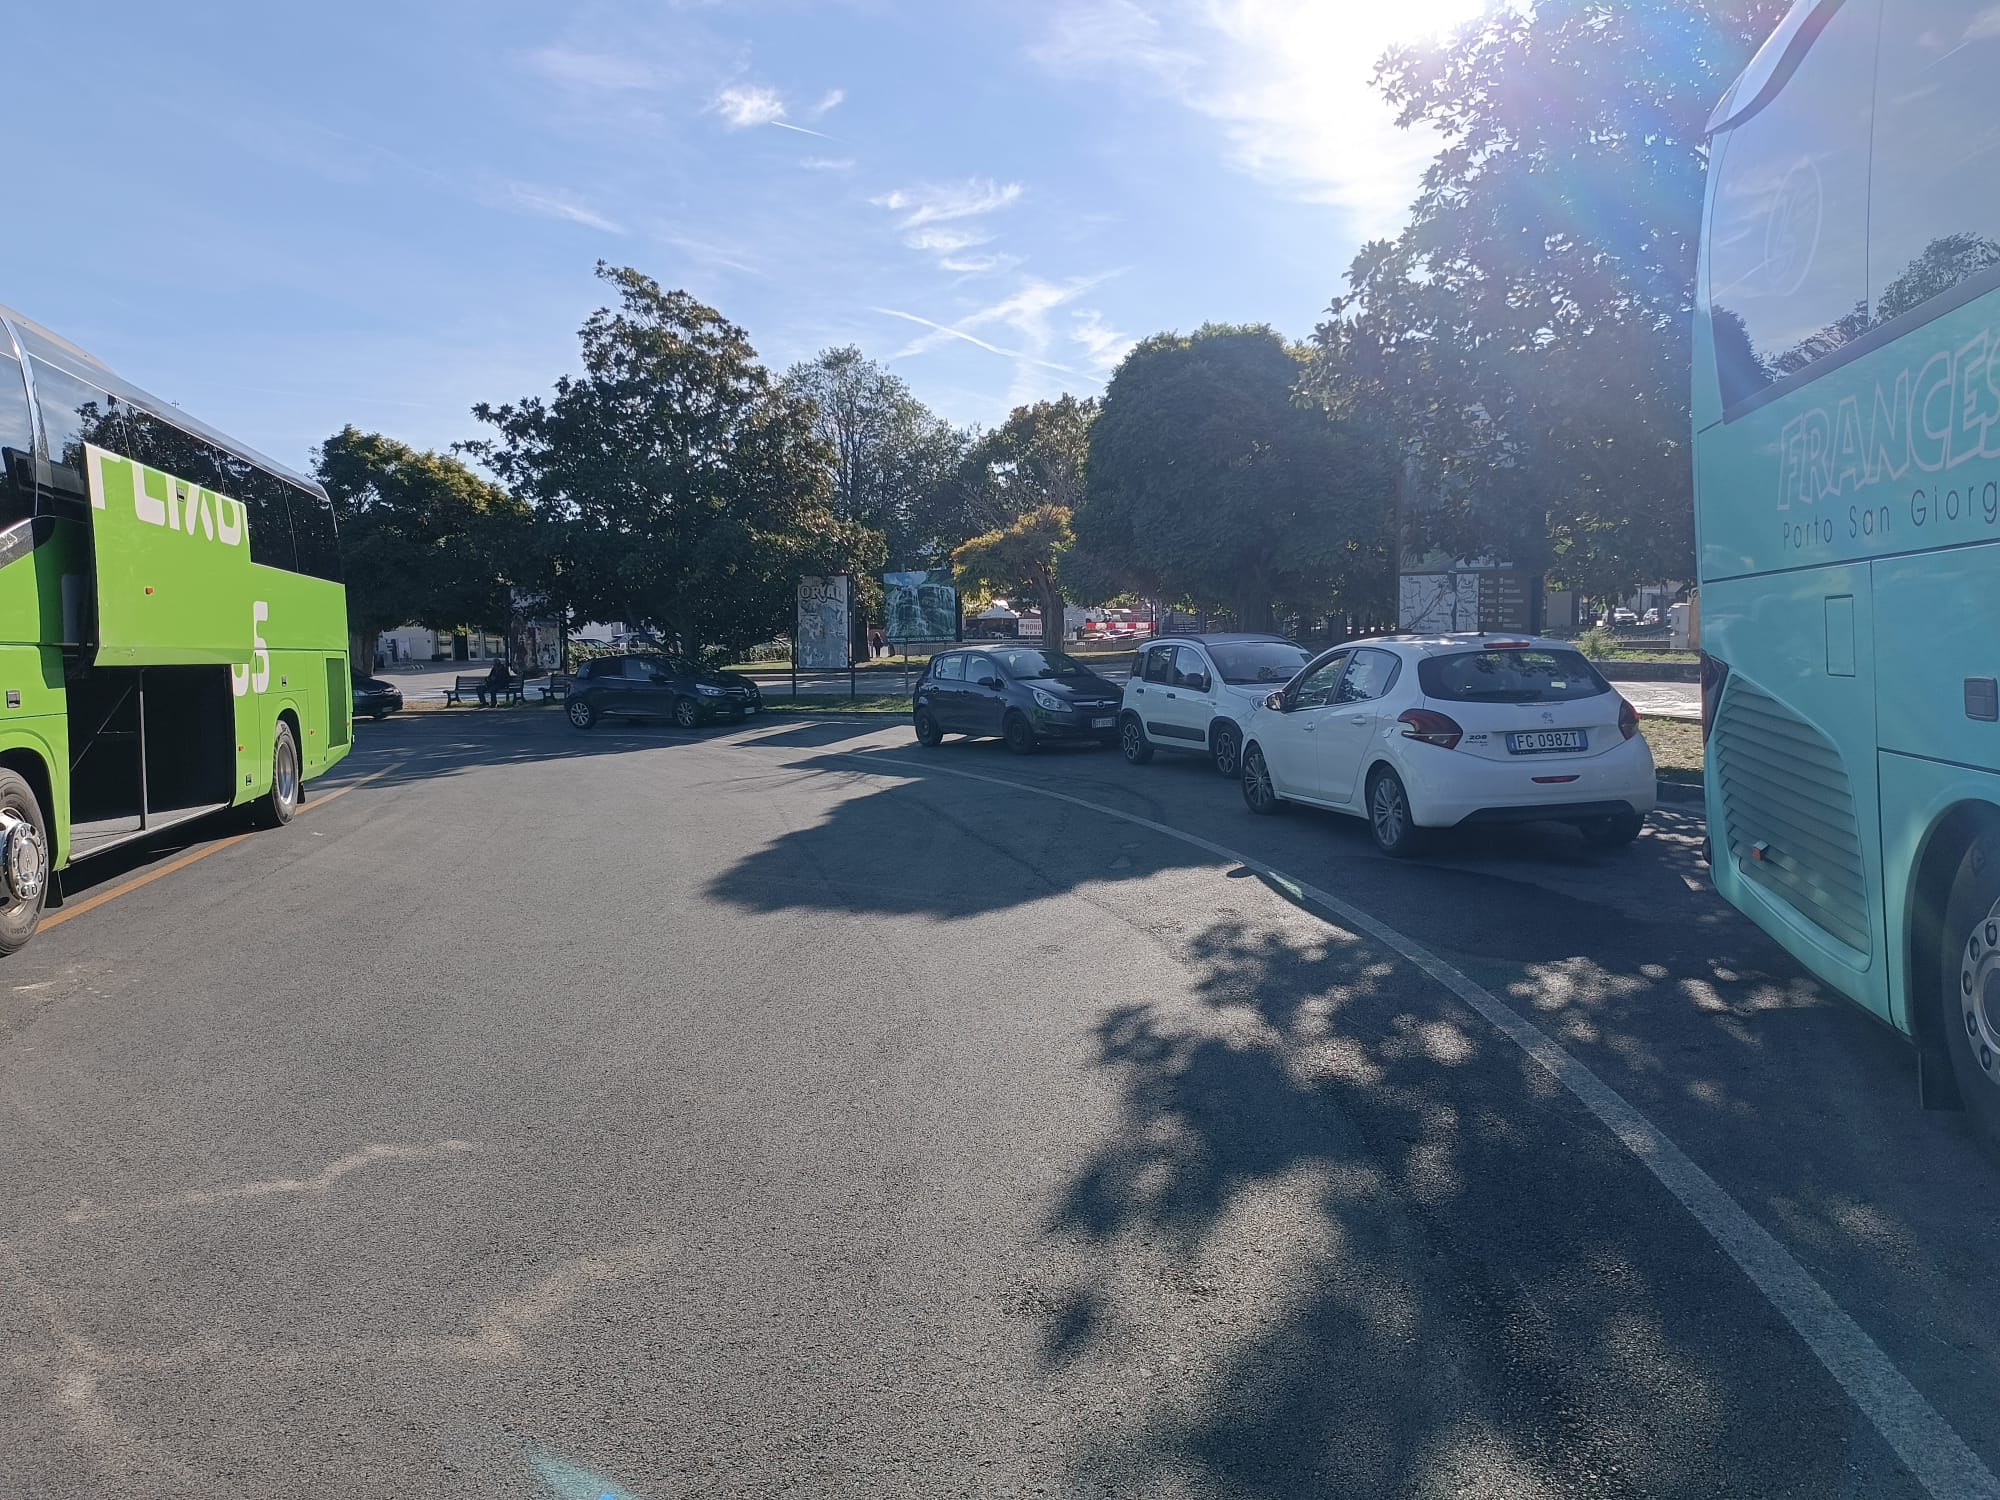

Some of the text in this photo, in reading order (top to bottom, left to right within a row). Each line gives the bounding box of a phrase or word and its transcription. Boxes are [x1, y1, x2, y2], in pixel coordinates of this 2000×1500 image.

[1783, 480, 1998, 549] Porto San Giorg
[1517, 732, 1577, 749] FG 098ZT
